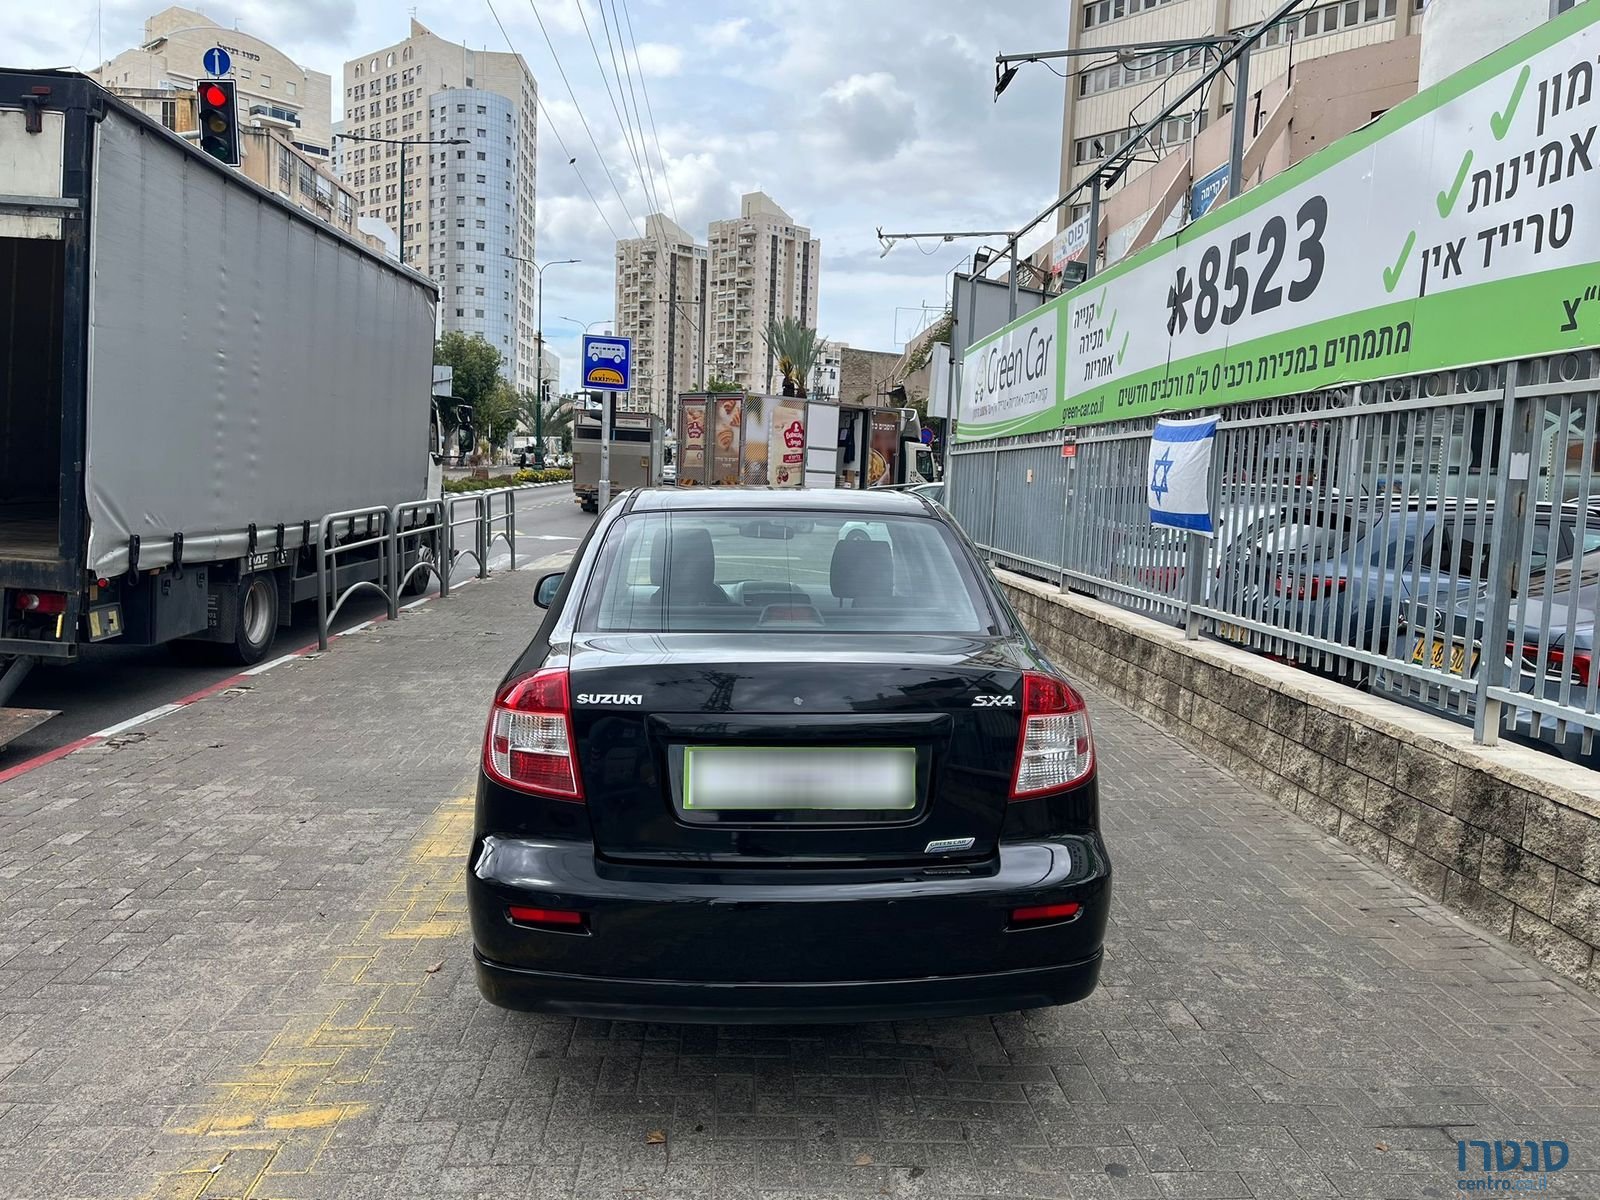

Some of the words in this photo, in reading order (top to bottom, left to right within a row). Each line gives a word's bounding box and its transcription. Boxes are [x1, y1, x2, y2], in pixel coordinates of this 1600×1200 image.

[1477, 203, 1574, 268] טרייד
[1419, 237, 1466, 298] אין
[1074, 303, 1095, 329] קנייה
[1079, 328, 1104, 355] מכירה
[1324, 321, 1411, 368] מתמחים
[987, 347, 1023, 395] Green
[1026, 326, 1053, 381] Car
[1084, 354, 1115, 382] אחריות
[1223, 360, 1252, 388] רכבי
[1256, 344, 1318, 382] במכירת
[1117, 383, 1149, 407] חדשים
[1150, 376, 1184, 401] ורכבים
[1062, 396, 1105, 423] green-car.co.il
[576, 693, 643, 705] SUZUKI
[971, 694, 1017, 707] SX4
